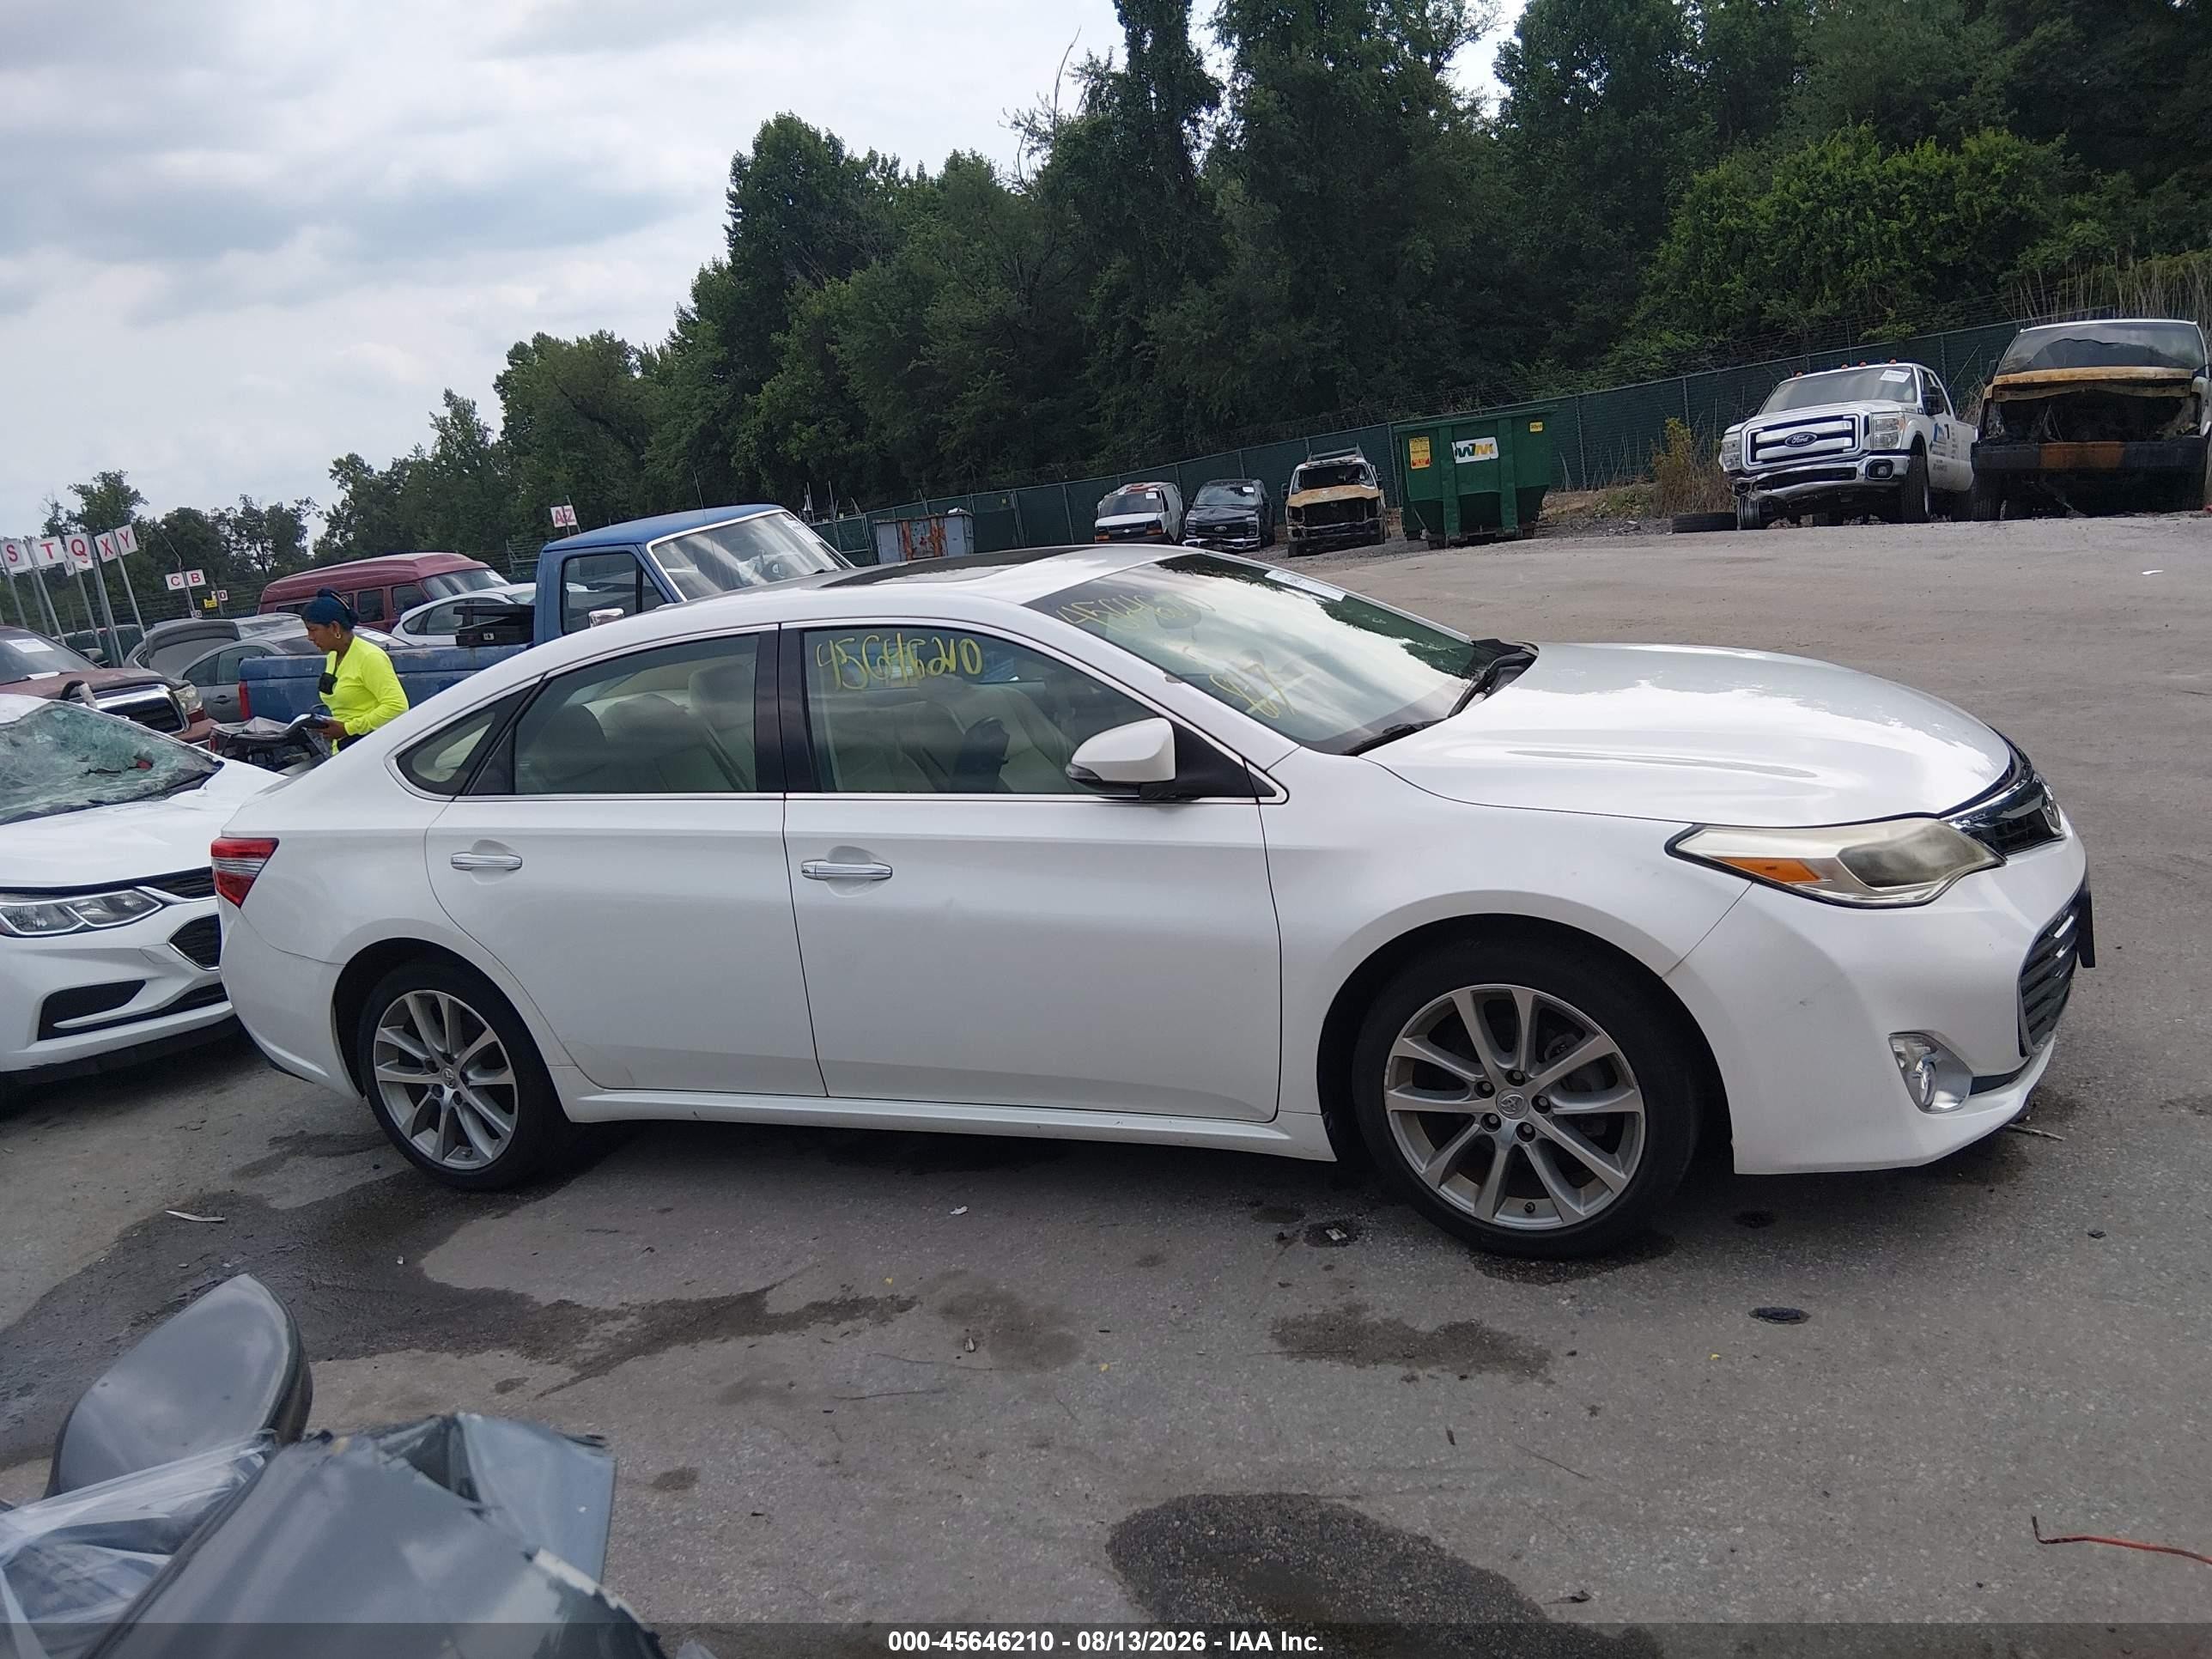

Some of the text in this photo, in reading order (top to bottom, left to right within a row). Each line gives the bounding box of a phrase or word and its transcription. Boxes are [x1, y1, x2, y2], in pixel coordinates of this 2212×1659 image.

[1791, 434, 1808, 444] Ford
[70, 538, 88, 556] Q
[100, 538, 113, 556] X
[119, 531, 130, 549] Y
[6, 544, 18, 562] S
[40, 542, 54, 559] T
[171, 575, 180, 586] C
[191, 573, 201, 583] B
[817, 632, 983, 690] 45646210
